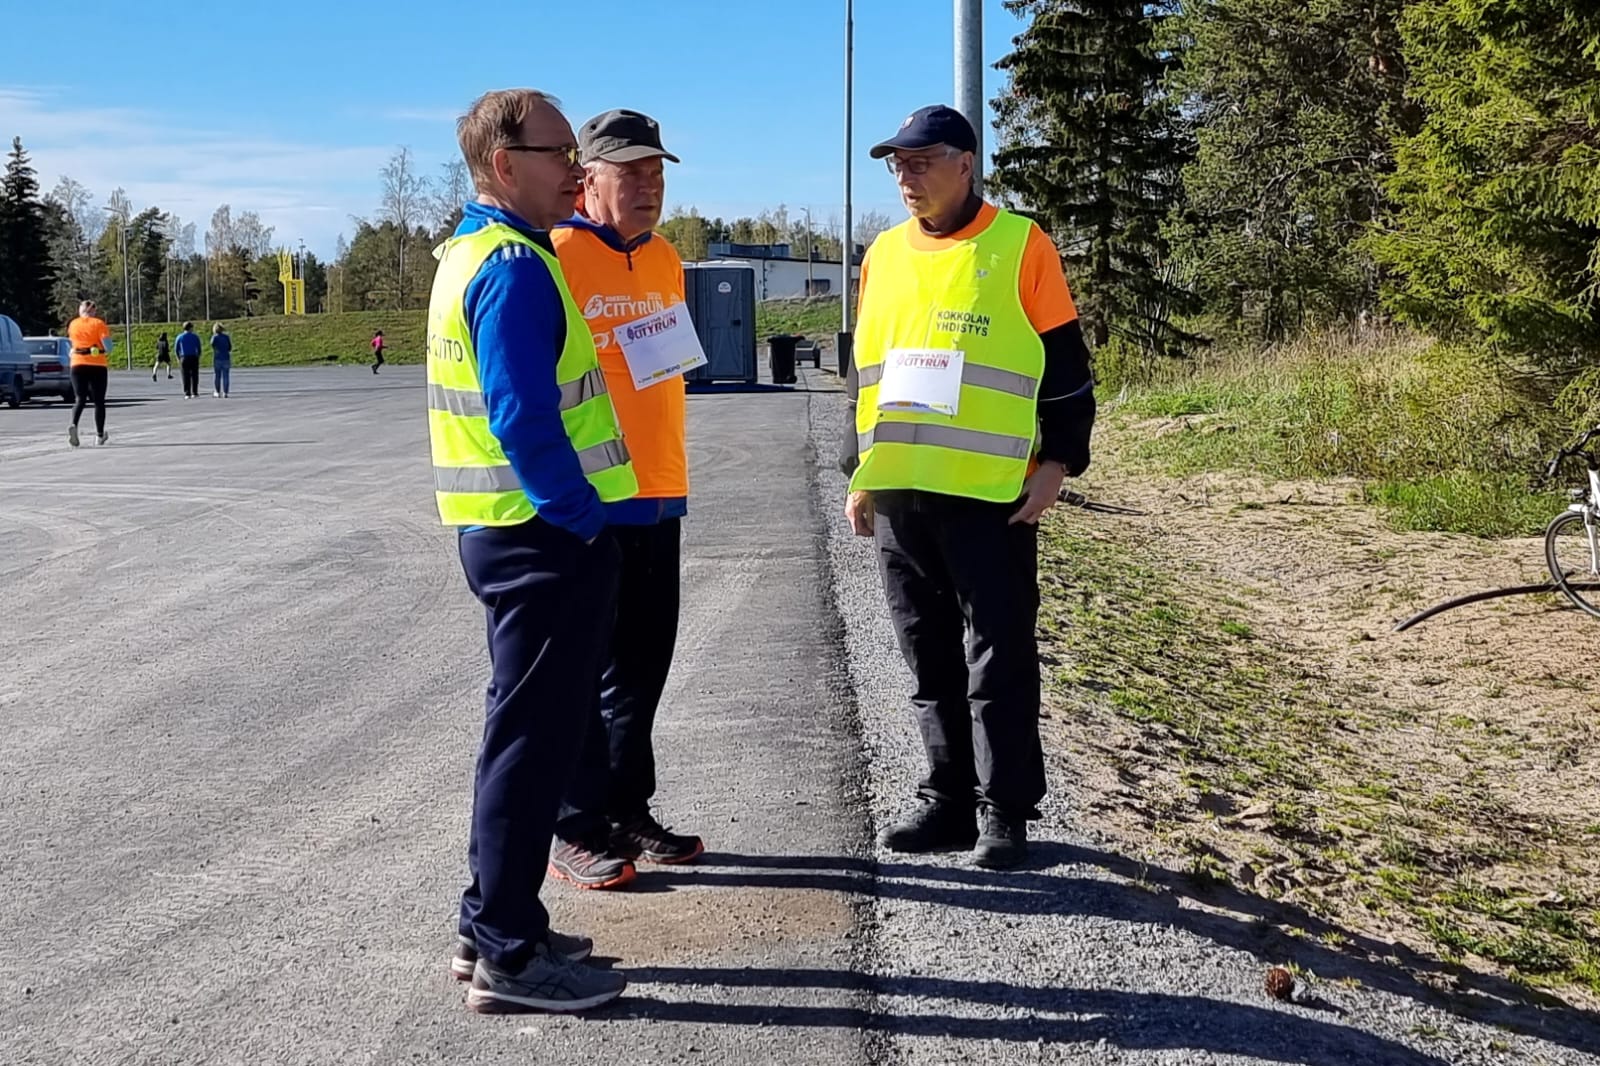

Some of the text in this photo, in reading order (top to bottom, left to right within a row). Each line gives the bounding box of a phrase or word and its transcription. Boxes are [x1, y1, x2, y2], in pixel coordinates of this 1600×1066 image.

[604, 300, 664, 317] CITYRUN
[937, 311, 990, 325] KOKKOLAN
[634, 316, 677, 339] CITYRUN
[936, 322, 988, 336] YHDISTYS
[904, 358, 949, 368] CITYRUN
